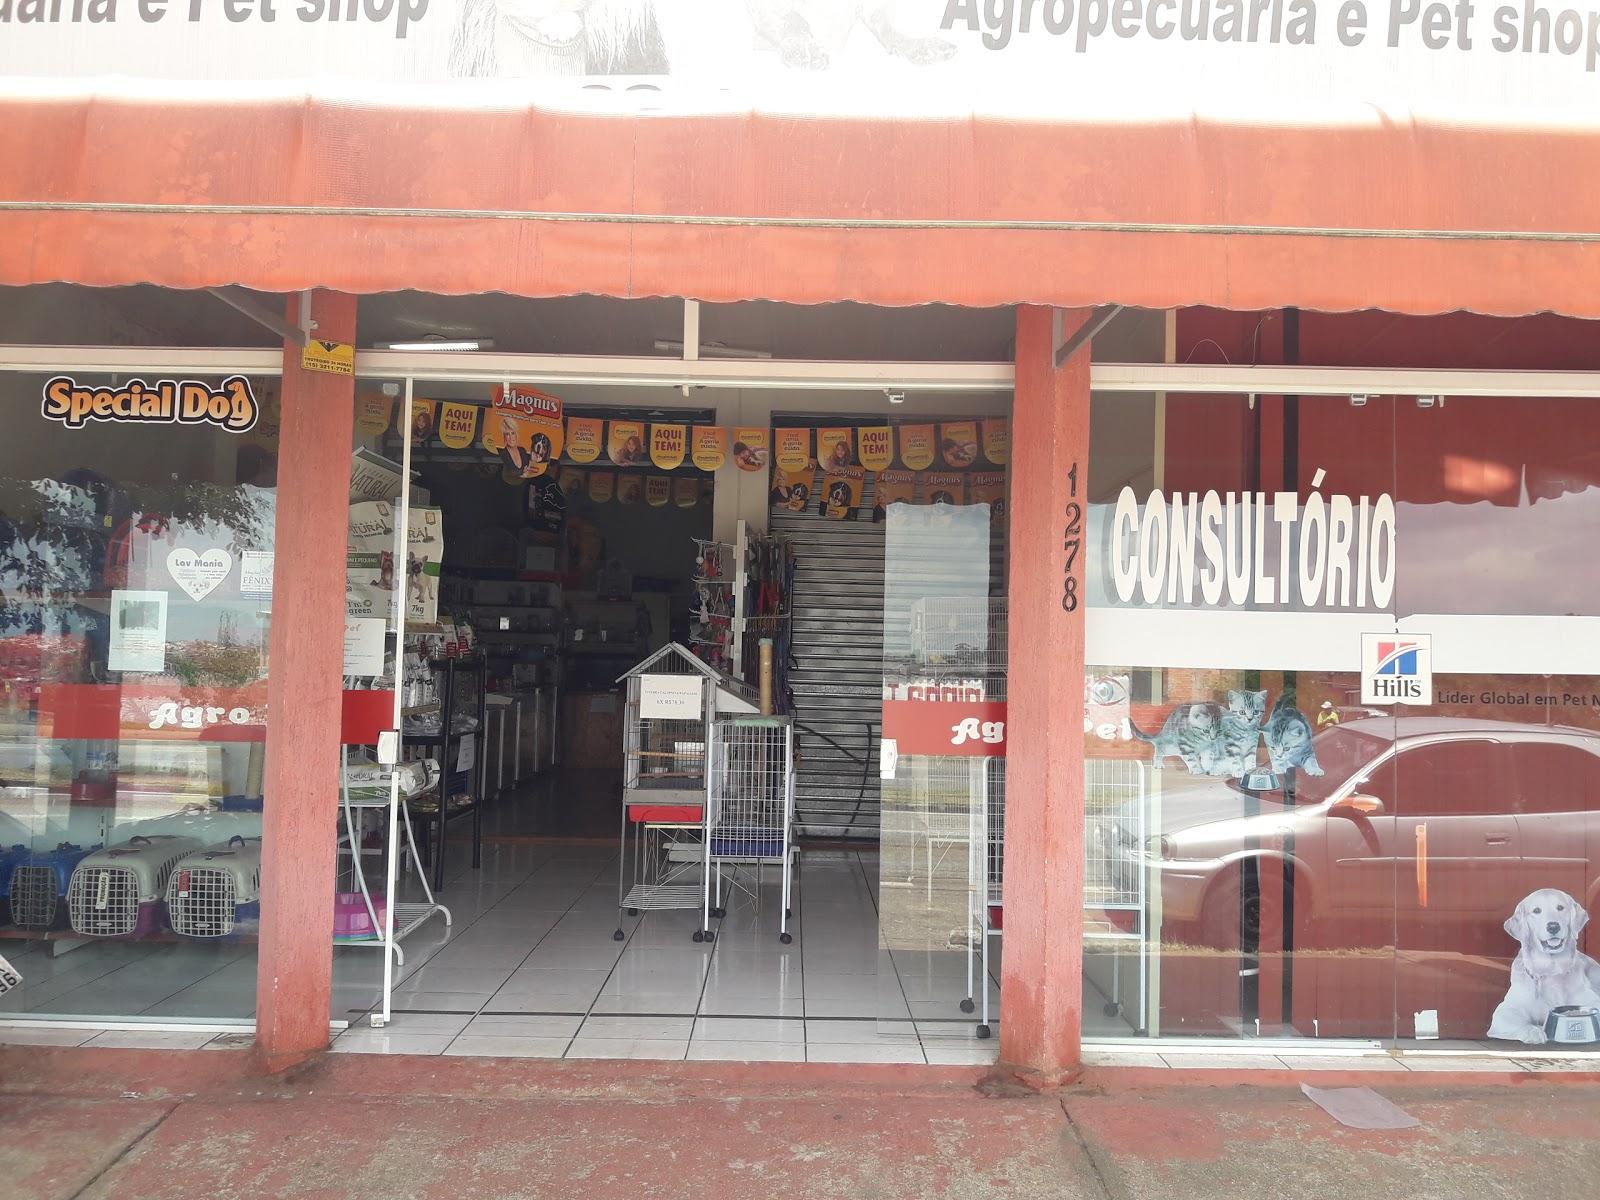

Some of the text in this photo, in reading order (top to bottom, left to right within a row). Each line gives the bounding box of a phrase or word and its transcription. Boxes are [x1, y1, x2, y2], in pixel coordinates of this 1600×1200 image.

[138, 0, 169, 24] e
[1337, 0, 1368, 47] e
[1387, 0, 1475, 51] Pet
[45, 377, 256, 430] Special Dog
[496, 390, 559, 414] Magnus
[446, 408, 473, 420] AQUI
[445, 420, 472, 433] TEM!
[654, 429, 683, 441] AQUI
[863, 432, 889, 444] AQUI
[655, 440, 682, 452] TEM!
[862, 444, 889, 455] TEM!
[826, 468, 863, 481] agnus
[877, 473, 913, 486] Magnus
[928, 475, 962, 487] Magnus
[351, 518, 387, 535] TURAL
[1062, 462, 1081, 613] 1278
[1112, 467, 1397, 609] CONSULTÓRIO
[175, 558, 224, 568] Lav Mania
[1373, 678, 1422, 699] Hill's
[1480, 692, 1530, 705] Global
[1535, 695, 1557, 706] em
[1563, 694, 1588, 706] Pet
[149, 702, 251, 729] Agro
[951, 717, 1005, 745] Ag
